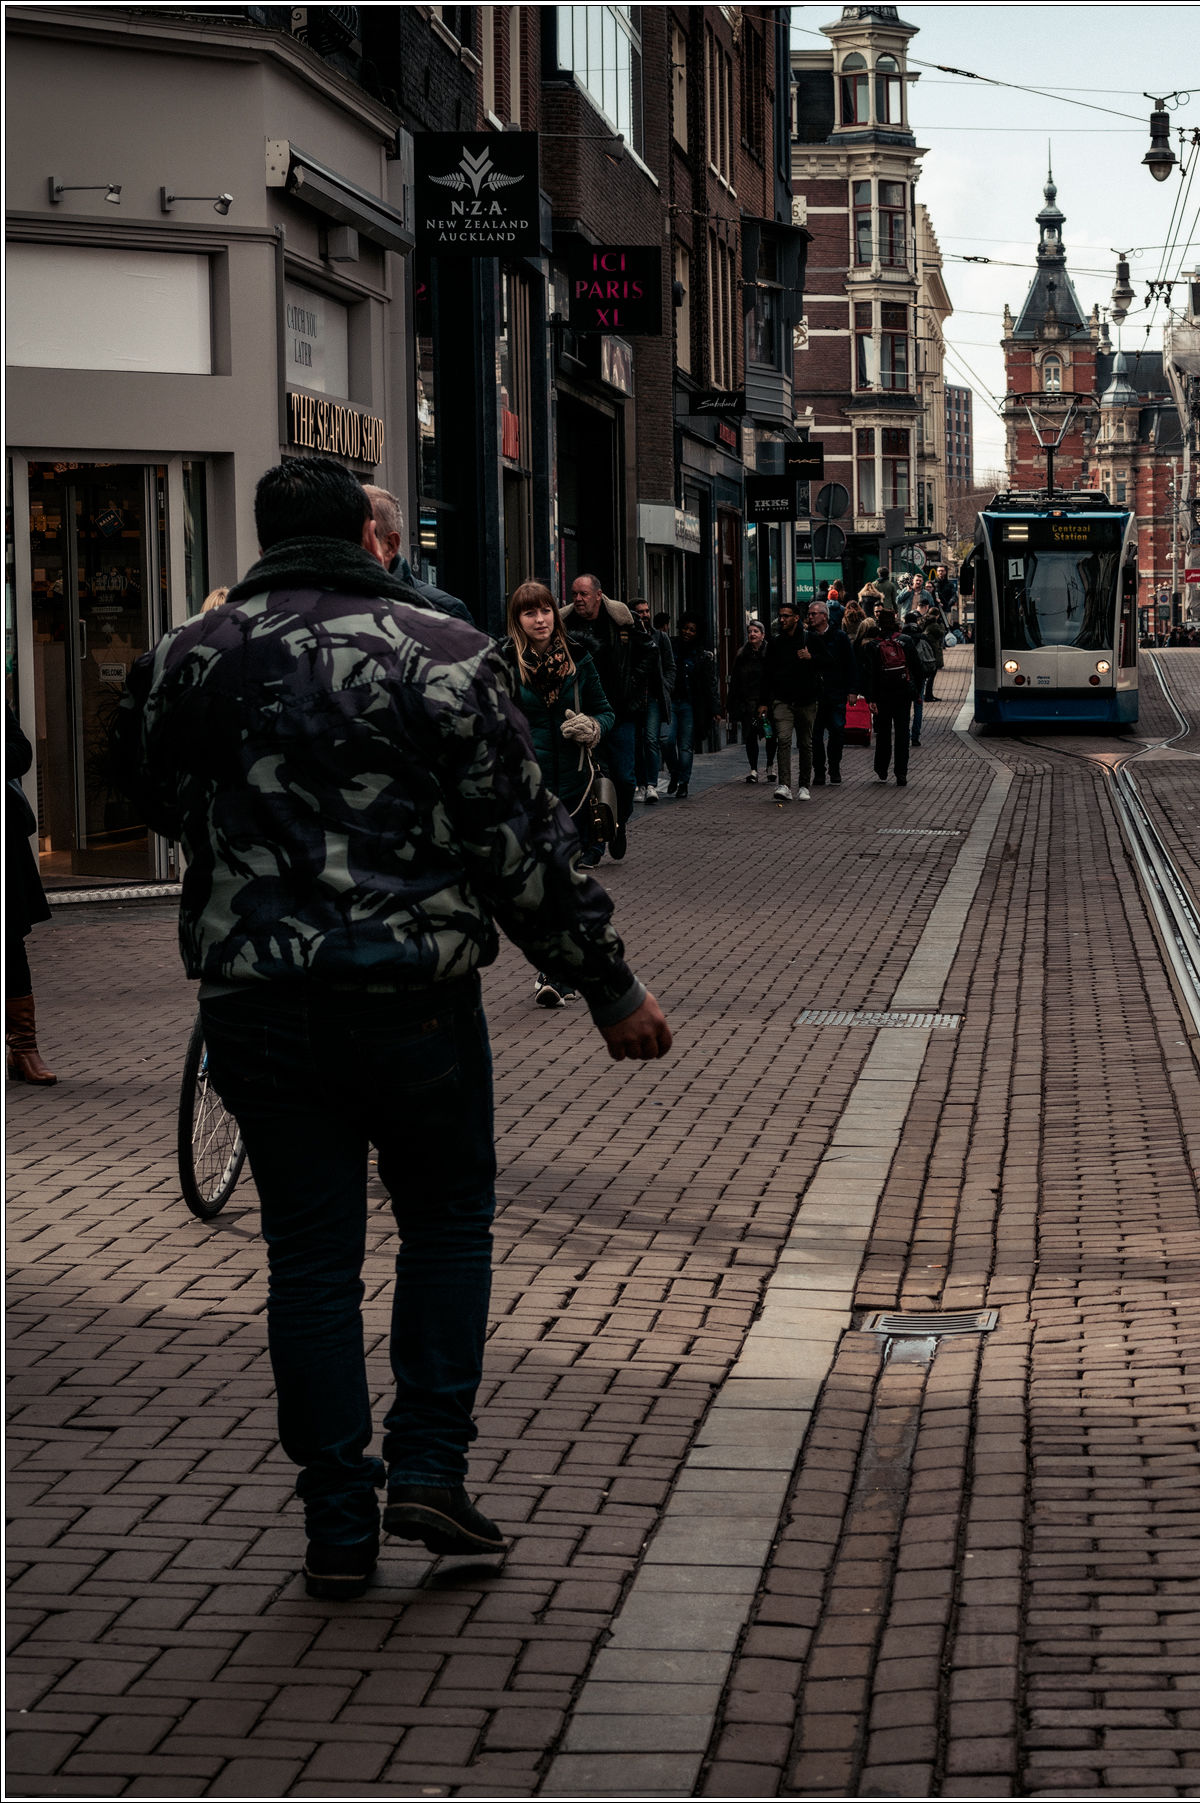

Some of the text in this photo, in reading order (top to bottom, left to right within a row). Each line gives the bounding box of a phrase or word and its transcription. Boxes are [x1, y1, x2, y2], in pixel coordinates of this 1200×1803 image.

[592, 252, 626, 272] ICI
[575, 280, 644, 299] PARIS
[286, 303, 318, 338] CATCH YOU
[596, 308, 625, 327] XL
[294, 338, 313, 368] LATER
[291, 392, 385, 464] THE SEAFOOD SHOP
[754, 499, 789, 507] IKKS
[1051, 523, 1091, 533] Centraal
[1053, 532, 1088, 541] Station
[1011, 561, 1022, 578] 1
